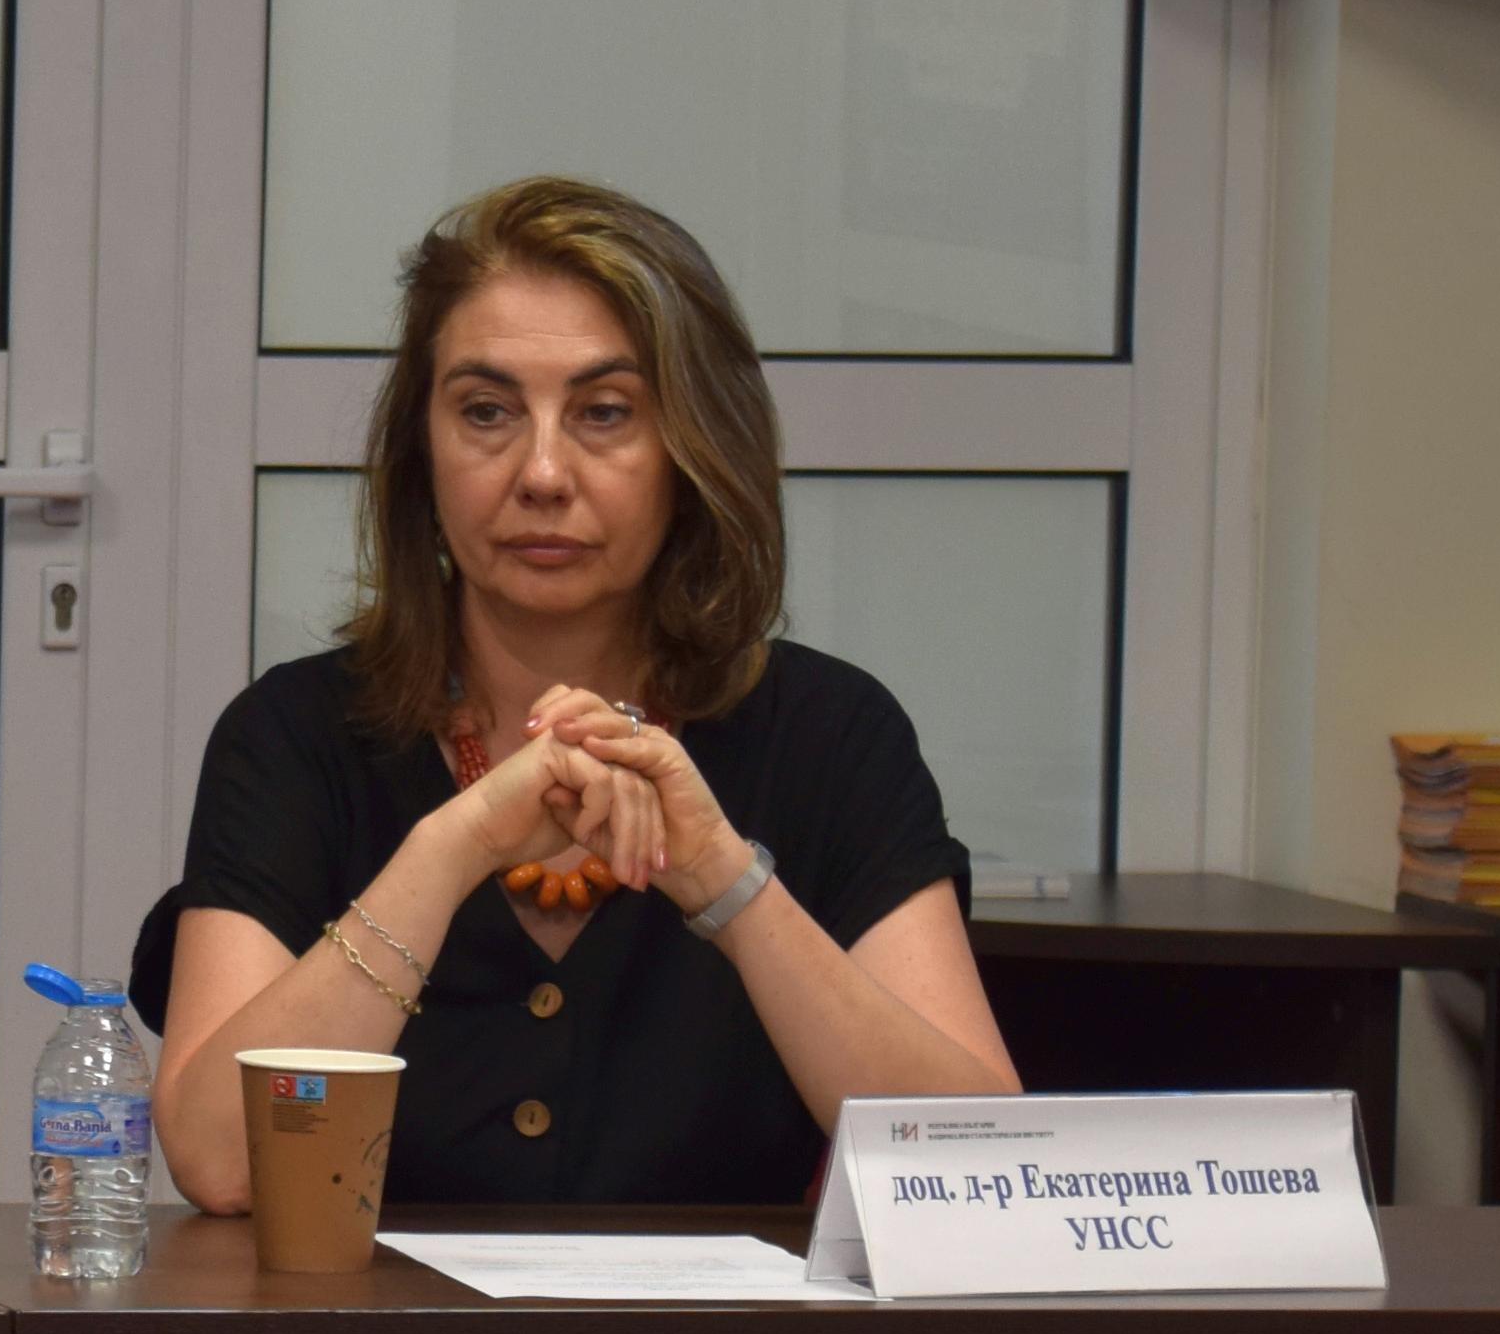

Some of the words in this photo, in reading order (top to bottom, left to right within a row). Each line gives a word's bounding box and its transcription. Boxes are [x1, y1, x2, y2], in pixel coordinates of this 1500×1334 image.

[893, 1173, 957, 1206] доц.
[966, 1173, 1014, 1209] д-р
[1019, 1164, 1191, 1207] Екатерина
[1196, 1159, 1321, 1197] Тошева
[1065, 1214, 1174, 1252] УНСС
